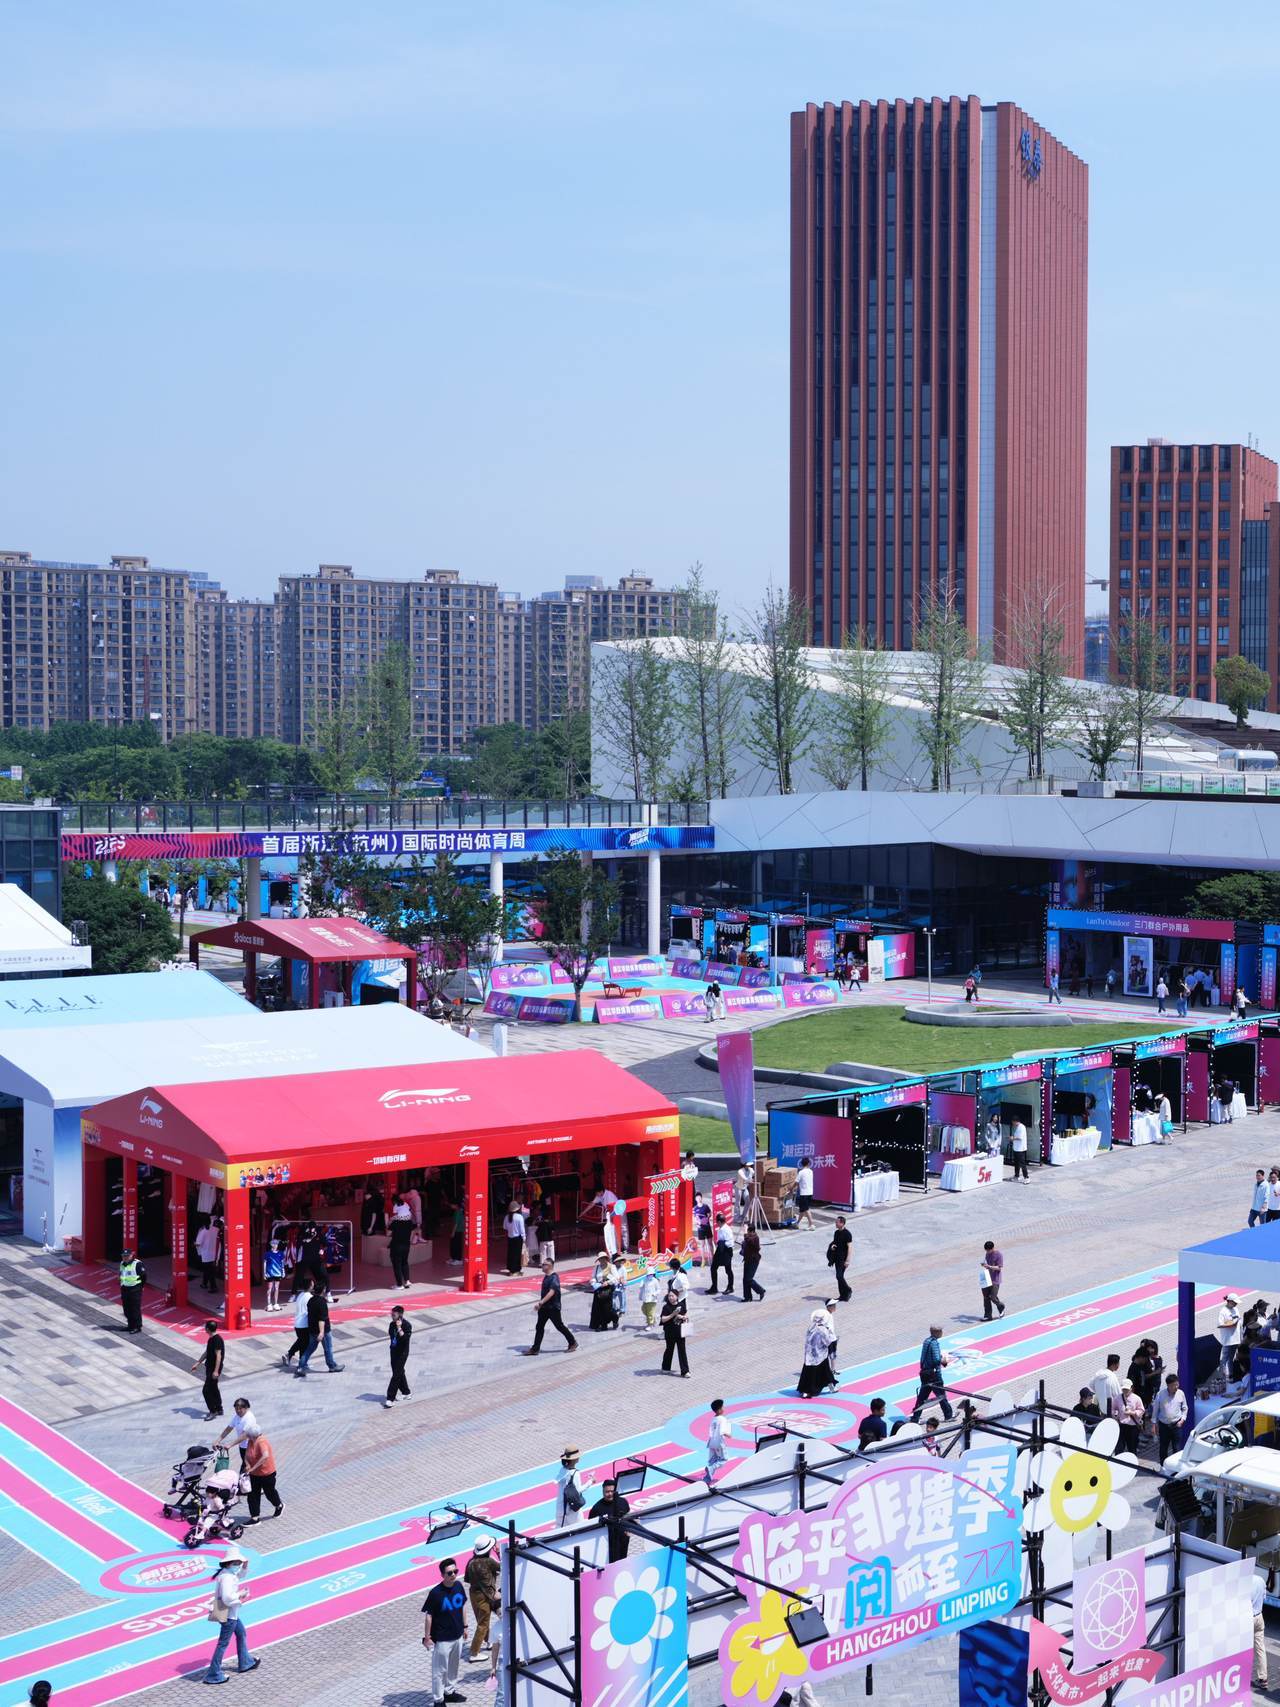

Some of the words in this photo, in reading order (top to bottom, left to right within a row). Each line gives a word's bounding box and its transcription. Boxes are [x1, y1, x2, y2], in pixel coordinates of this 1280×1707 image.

[139, 1113, 164, 1129] LI-NING
[384, 1095, 473, 1109] LI-NING
[741, 1453, 1015, 1586] 临平非遗季
[825, 1609, 932, 1664] HANGZHOU
[941, 1582, 1009, 1623] LINPING
